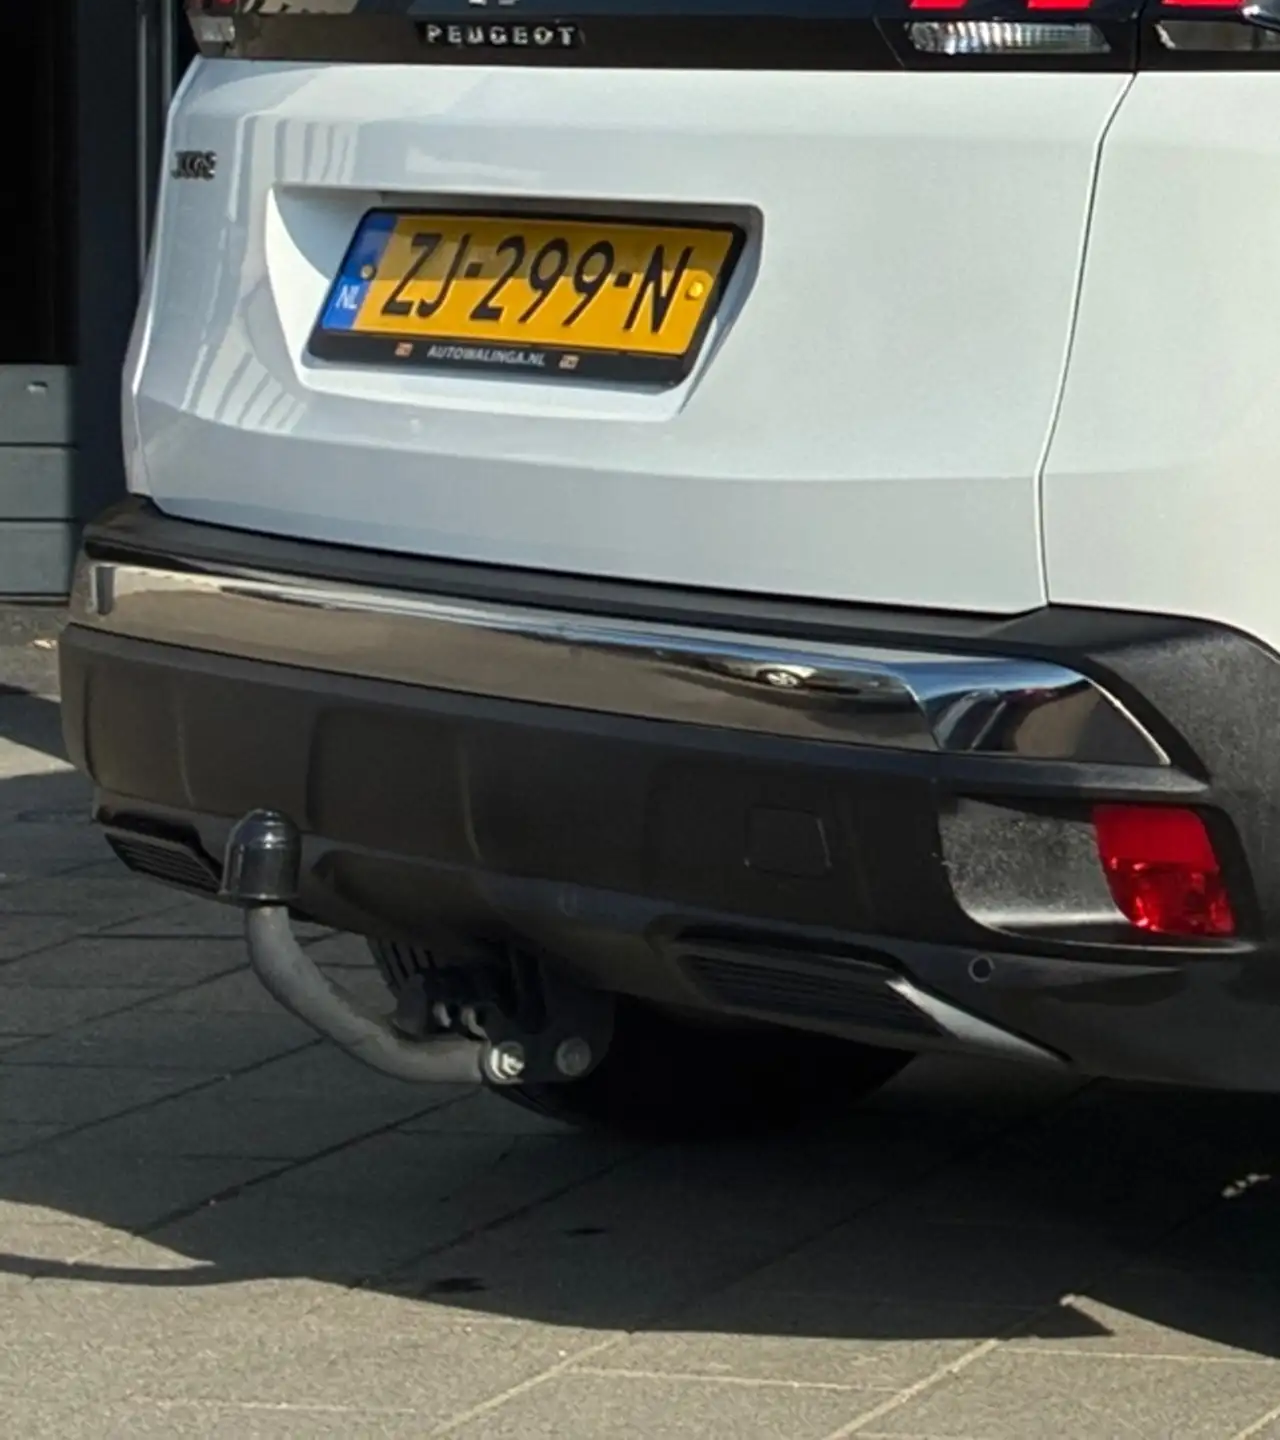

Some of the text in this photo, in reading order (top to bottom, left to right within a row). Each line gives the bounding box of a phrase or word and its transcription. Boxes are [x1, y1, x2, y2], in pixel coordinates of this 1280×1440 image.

[427, 23, 575, 46] PEUGEOT
[380, 232, 695, 335] ZJ-299-N
[335, 284, 360, 310] NL
[427, 343, 547, 367] AUTOWALINGA.NL
